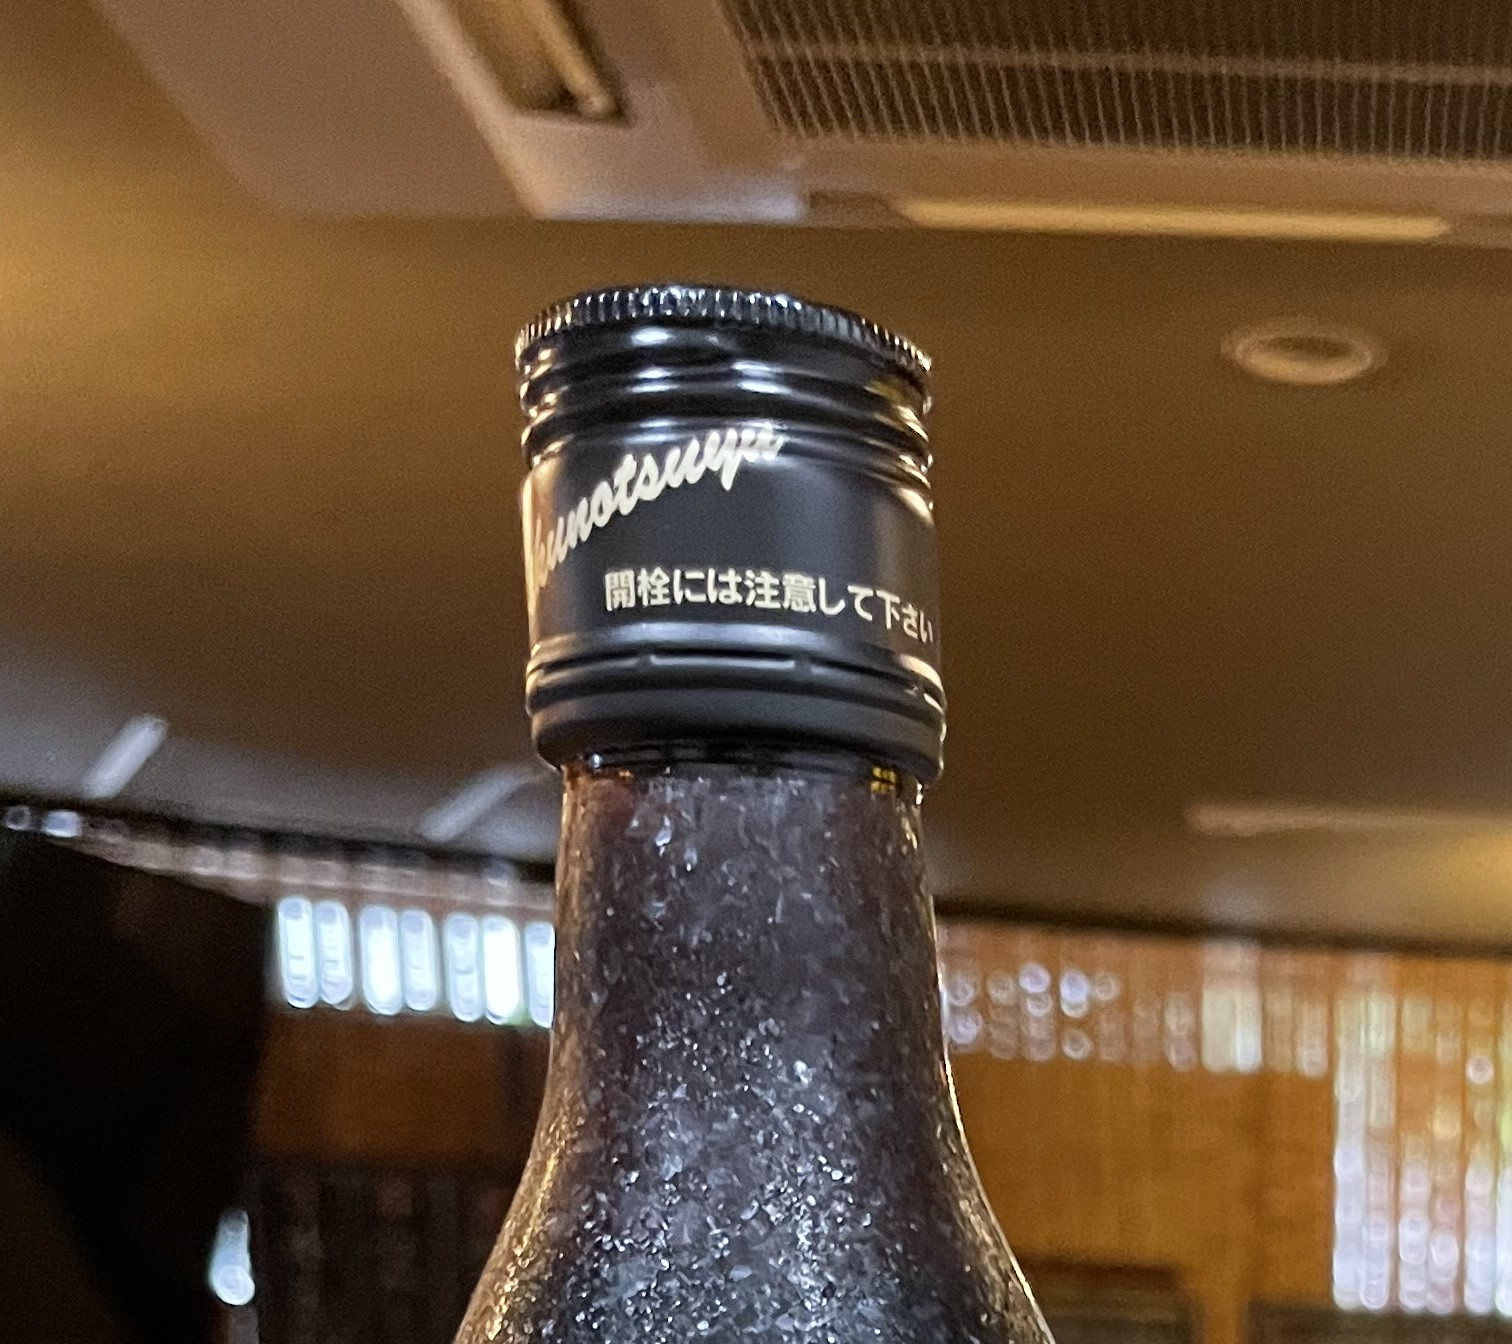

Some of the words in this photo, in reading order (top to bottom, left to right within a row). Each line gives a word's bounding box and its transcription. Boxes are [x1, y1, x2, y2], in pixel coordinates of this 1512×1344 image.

[604, 567, 934, 643] 開栓には注意して下さい
